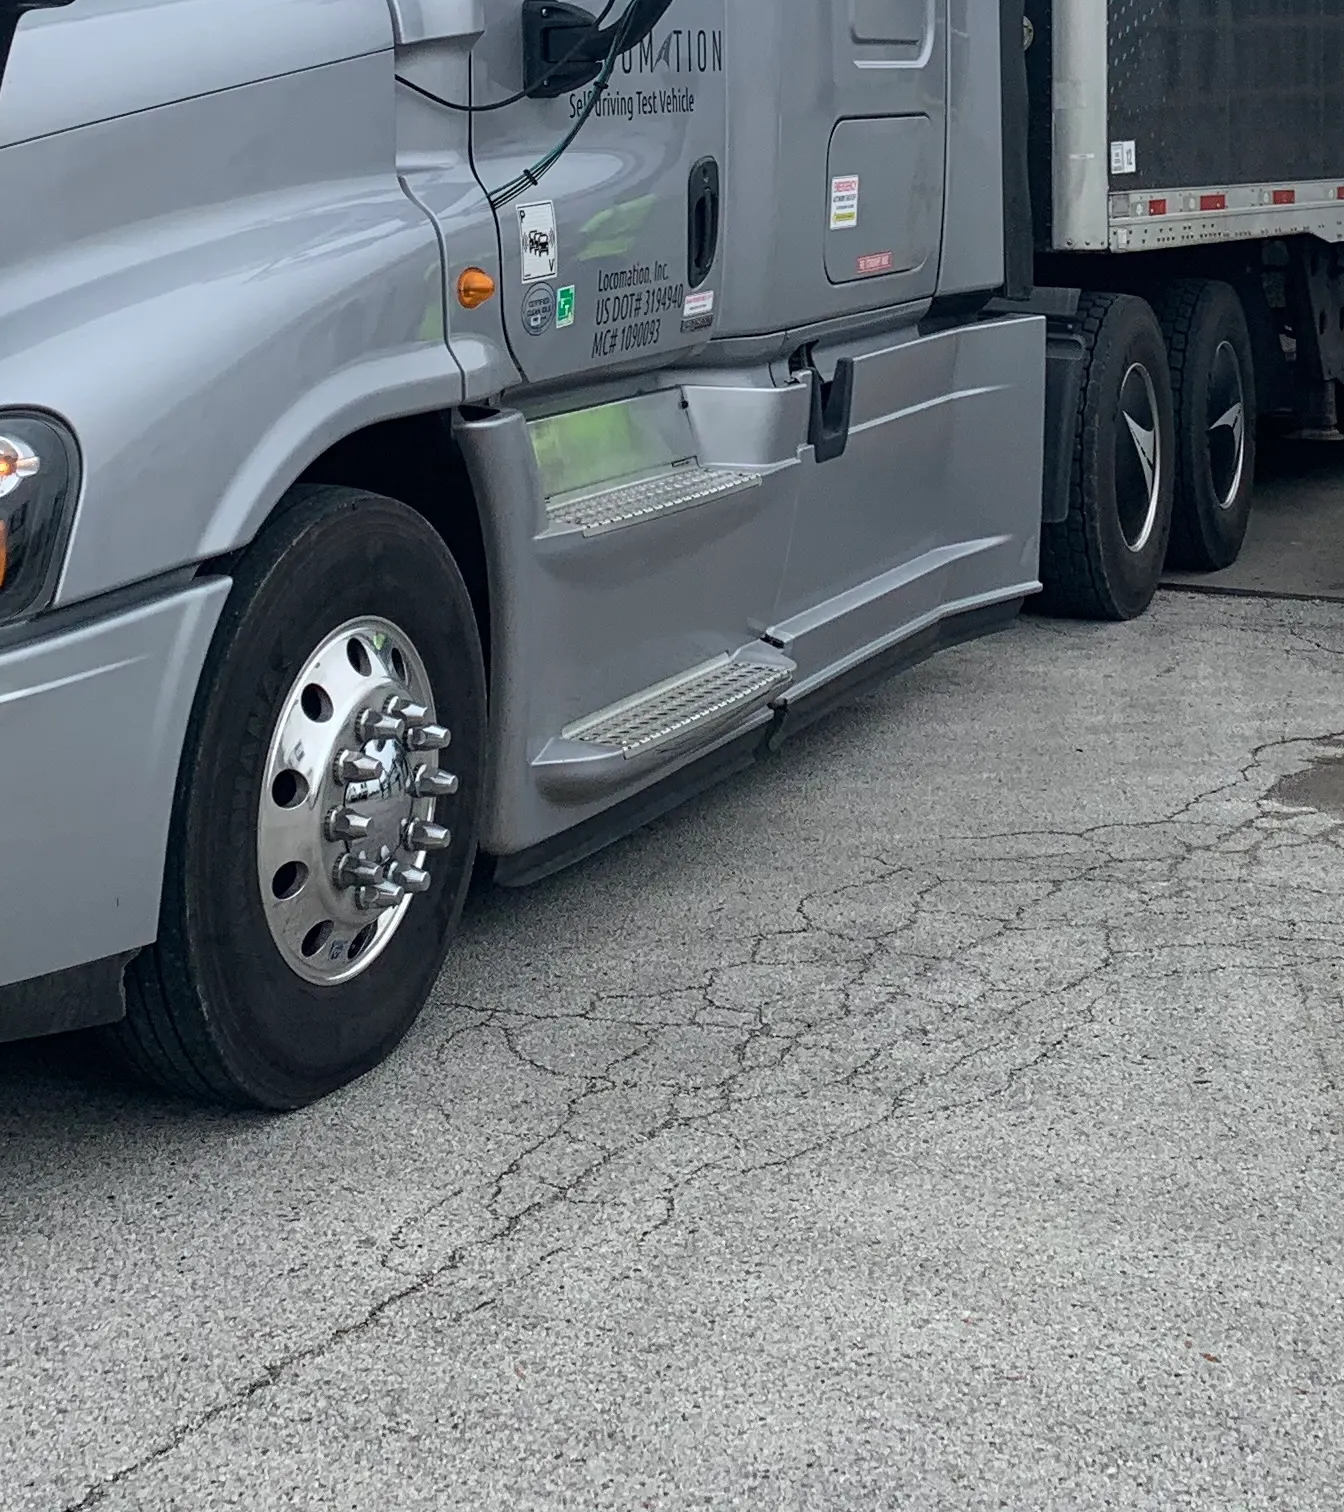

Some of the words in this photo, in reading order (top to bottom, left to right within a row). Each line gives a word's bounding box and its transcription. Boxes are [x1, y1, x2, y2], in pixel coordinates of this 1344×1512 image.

[636, 90, 657, 114] Test
[659, 87, 695, 114] Vehicle
[598, 262, 652, 292] Locomation,
[596, 297, 611, 326] US
[612, 292, 642, 323] DOT#
[644, 283, 684, 316] 3194940
[591, 329, 618, 359] MC#
[620, 319, 660, 352] 1090093
